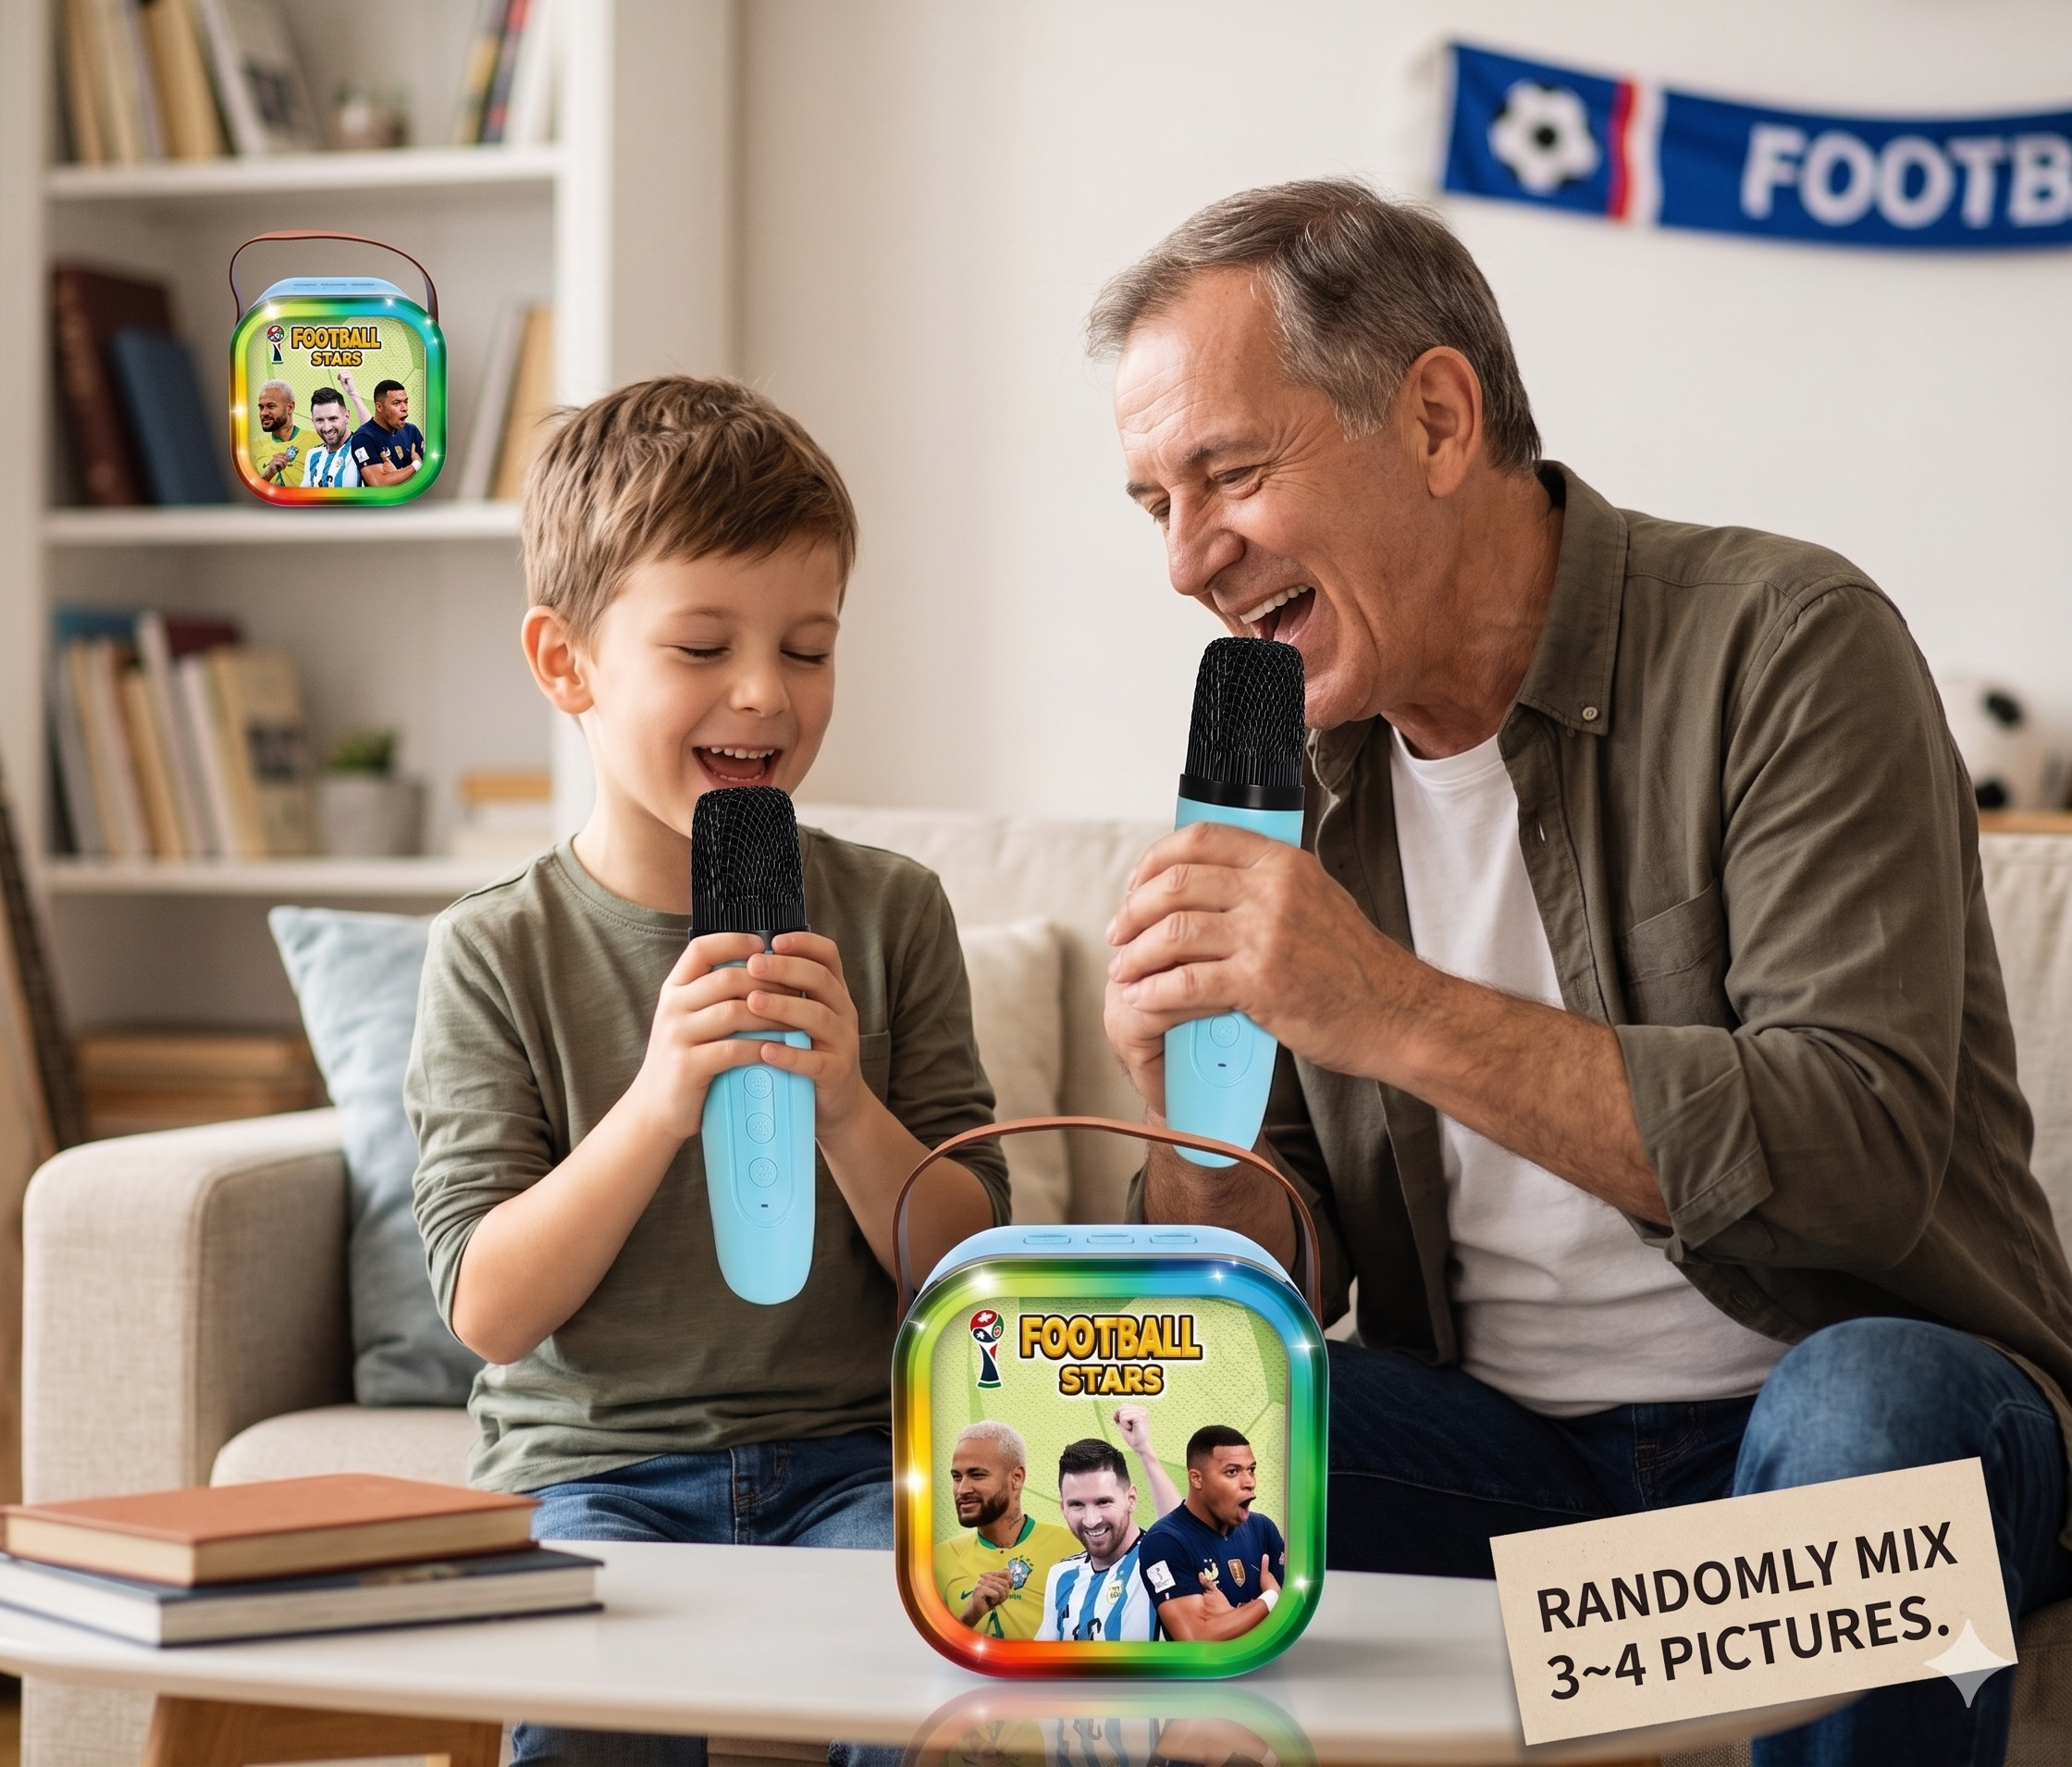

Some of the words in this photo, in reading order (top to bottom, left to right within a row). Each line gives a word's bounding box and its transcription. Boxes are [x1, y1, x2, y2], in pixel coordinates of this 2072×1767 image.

[1741, 122, 2072, 229] FOOTB
[291, 327, 381, 349] FOOTBALL
[311, 351, 363, 366] STARS
[1019, 1315, 1202, 1360] FOOTBALL
[1059, 1364, 1164, 1395] STARS
